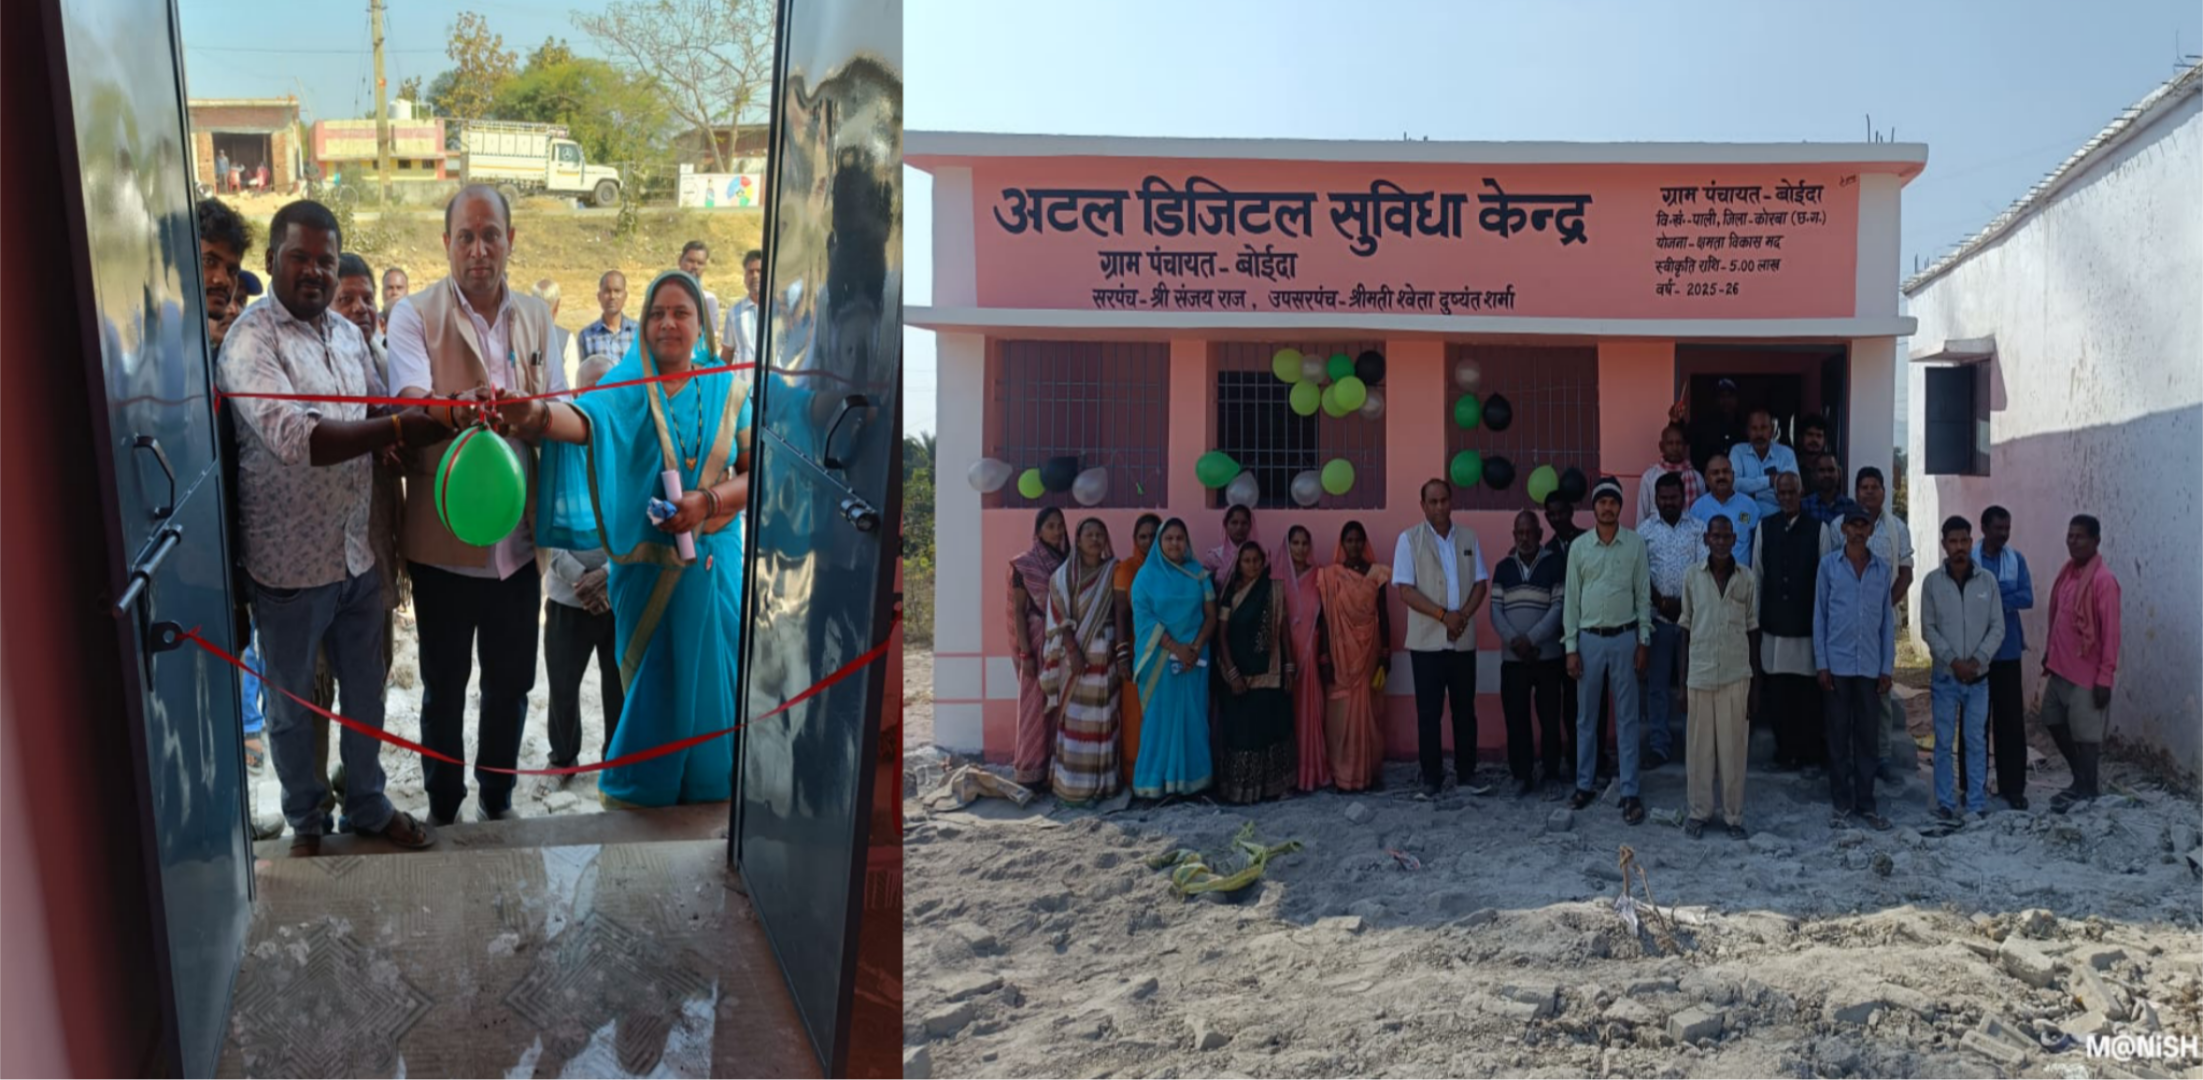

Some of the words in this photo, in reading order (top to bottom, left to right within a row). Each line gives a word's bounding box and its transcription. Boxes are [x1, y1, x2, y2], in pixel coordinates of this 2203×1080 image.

[1660, 186, 1698, 207] ग्राम
[993, 187, 1130, 237] अटल
[1135, 175, 1317, 239] डिजिटल
[1328, 178, 1468, 257] सुविधा
[1477, 177, 1593, 247] केन्द्र
[1729, 231, 1763, 250] विकास
[1765, 235, 1784, 250] मद
[1098, 250, 1142, 280] ग्राम
[1235, 244, 1298, 282] बोईदा
[1655, 256, 1697, 277] स्वीकृति
[1729, 259, 1755, 273] 5.00
[1757, 258, 1782, 273] लाख
[1174, 284, 1215, 310] संजय
[1397, 283, 1434, 311] श्वेता
[1439, 285, 1482, 316] दुष्यंत
[1484, 284, 1516, 310] शर्मा
[1687, 282, 1739, 296] 2025-26
